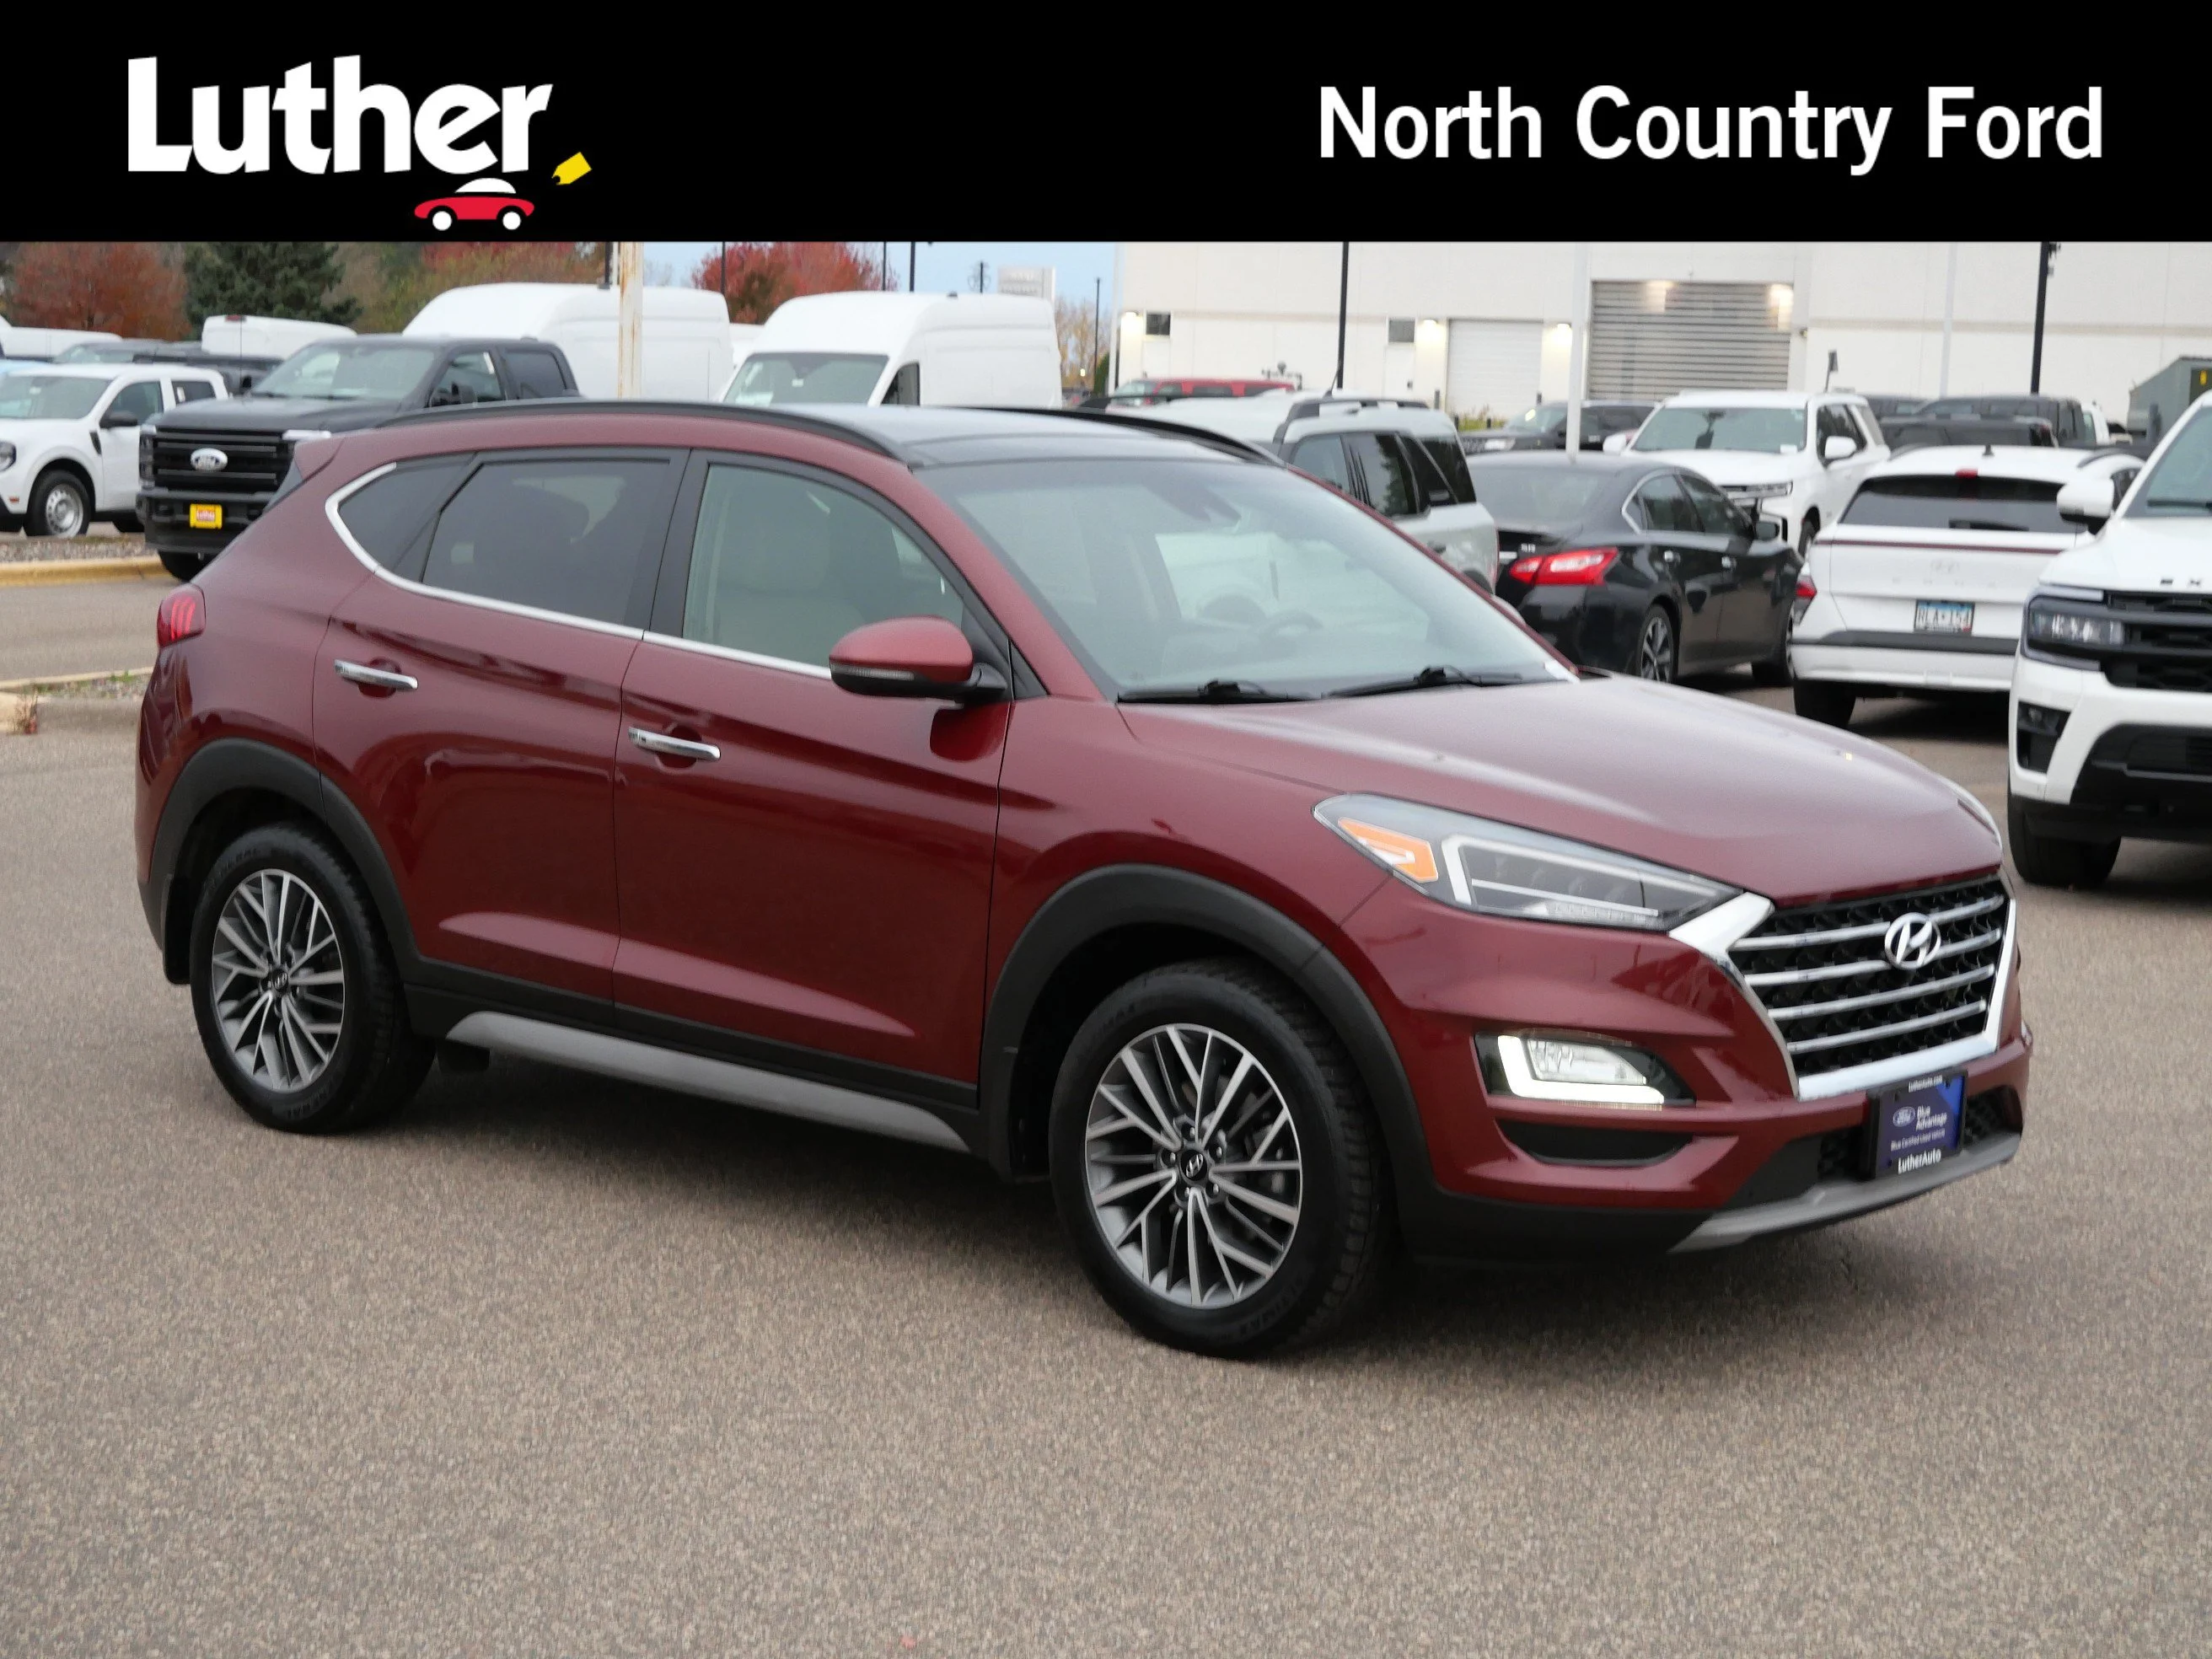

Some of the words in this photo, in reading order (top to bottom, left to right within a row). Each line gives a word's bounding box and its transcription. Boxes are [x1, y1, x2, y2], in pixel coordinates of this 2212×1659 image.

[1916, 1105, 1931, 1119] Blue
[1915, 1113, 1947, 1131] Advantage
[1898, 1147, 1941, 1175] LutherAuto
